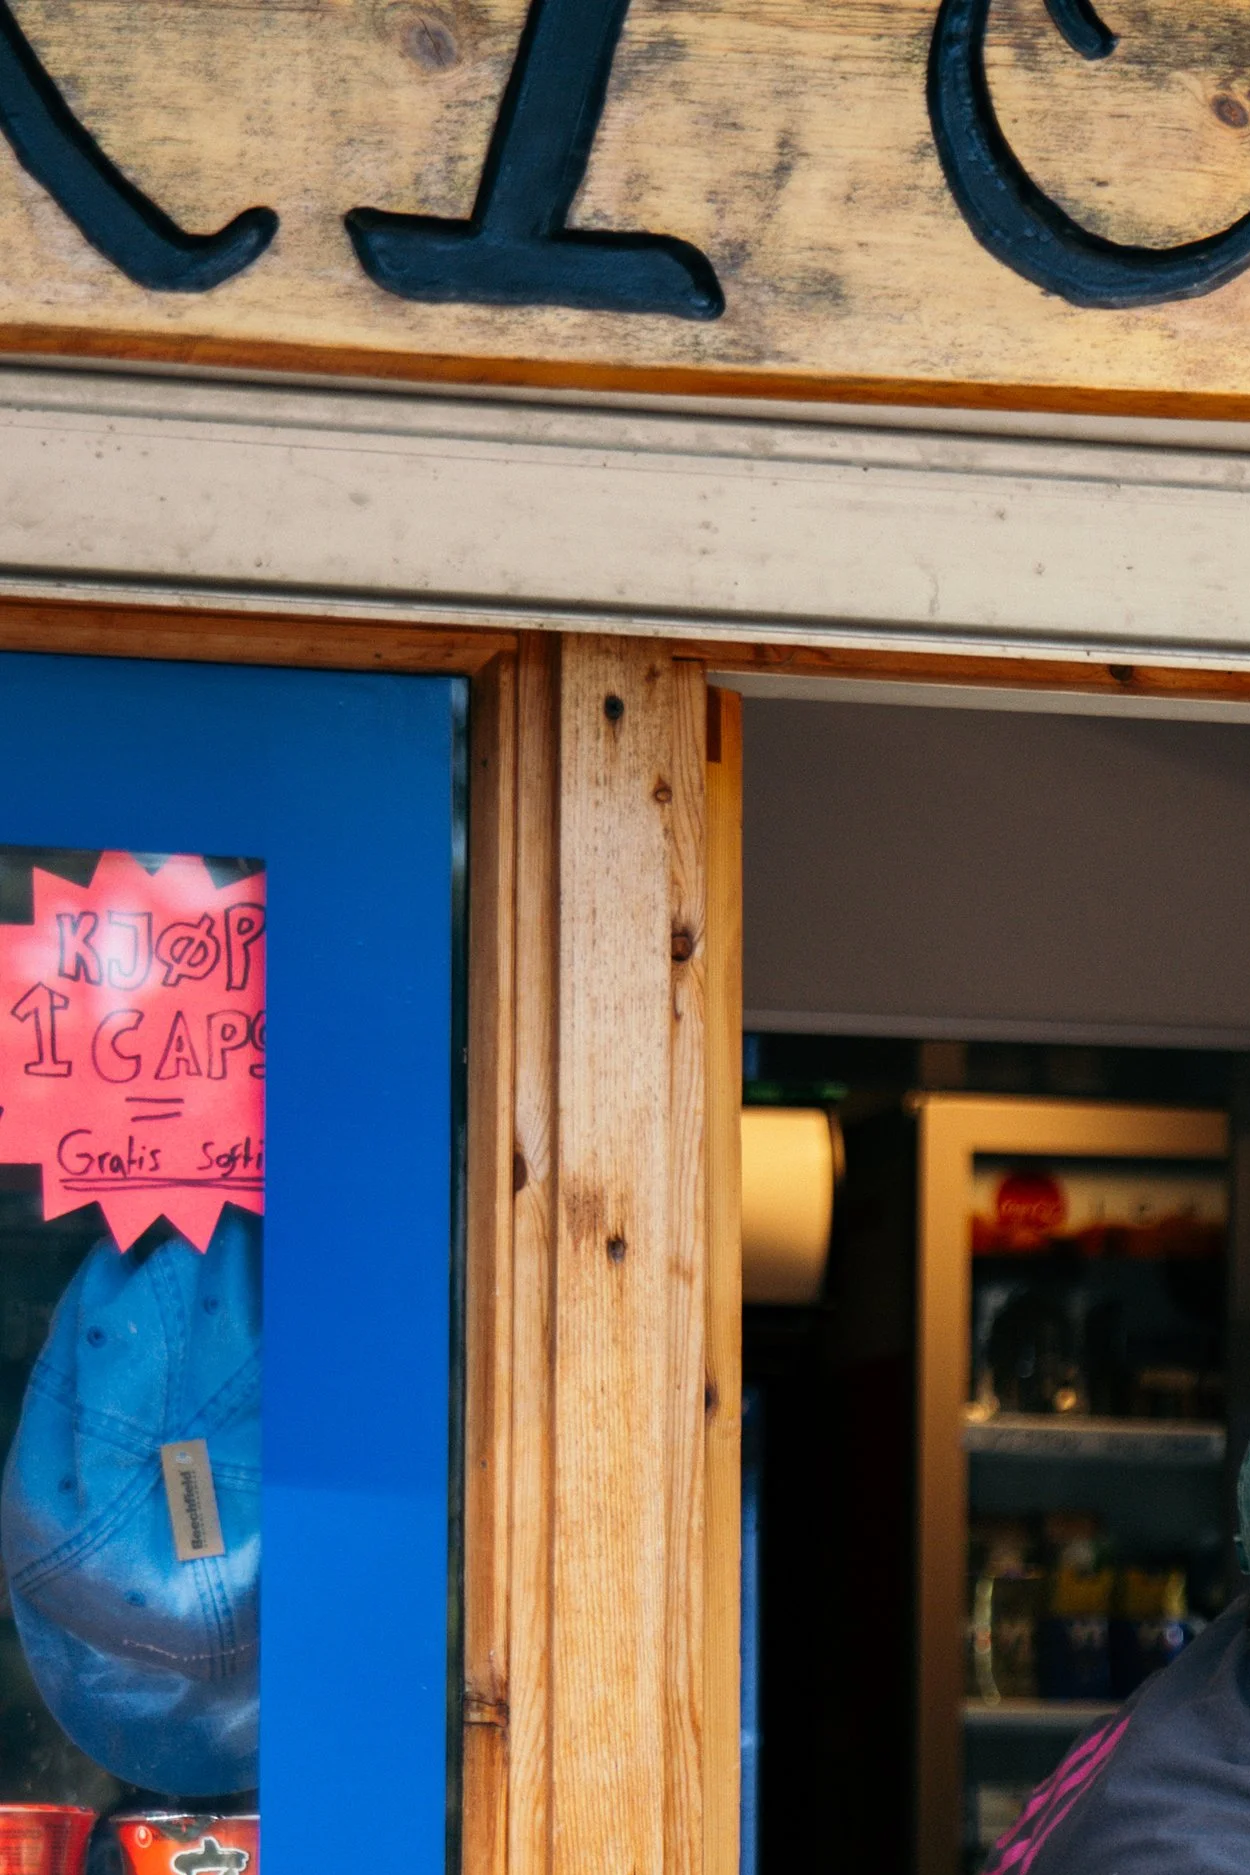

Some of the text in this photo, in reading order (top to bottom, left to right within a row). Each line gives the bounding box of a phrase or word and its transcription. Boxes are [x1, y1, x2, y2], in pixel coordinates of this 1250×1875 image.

[56, 903, 265, 991] KJØP
[11, 981, 73, 1078] 1
[57, 1129, 162, 1178] Gratis
